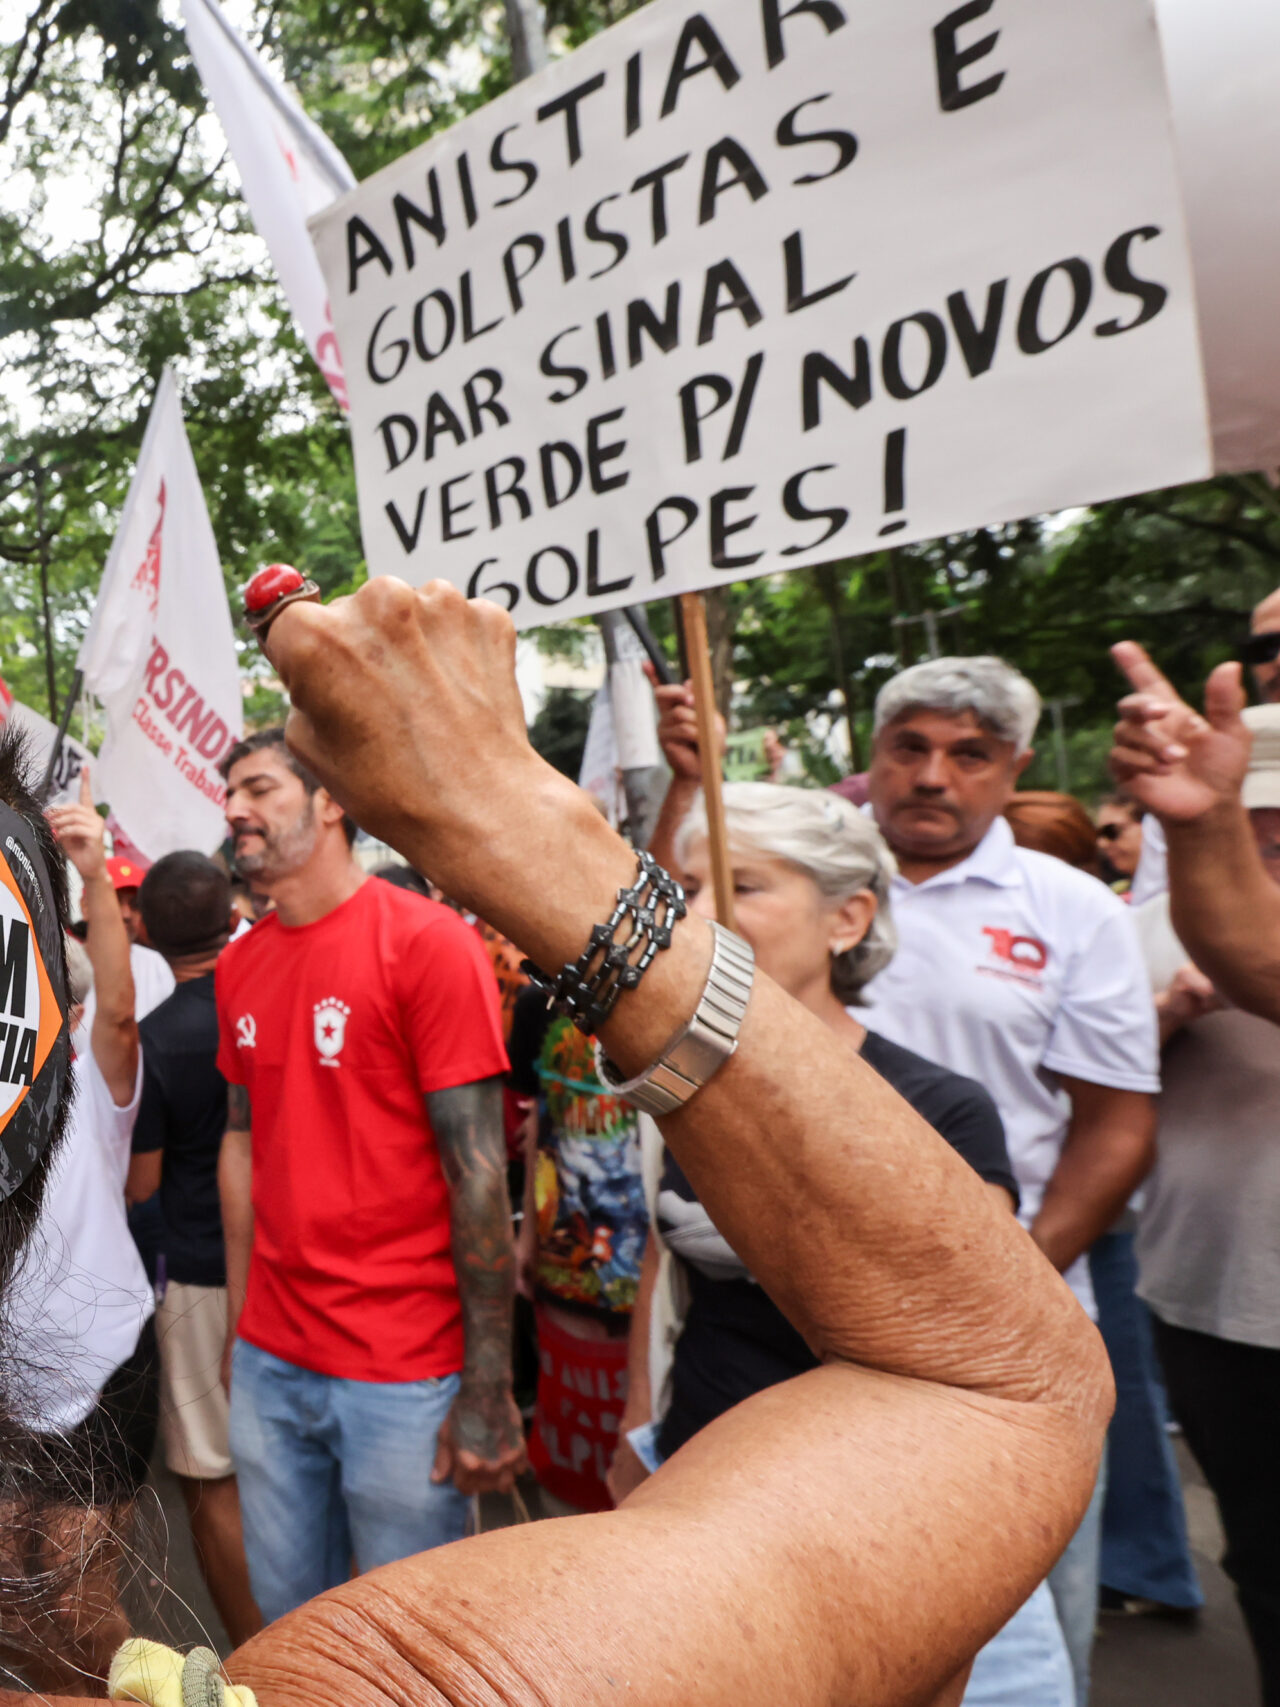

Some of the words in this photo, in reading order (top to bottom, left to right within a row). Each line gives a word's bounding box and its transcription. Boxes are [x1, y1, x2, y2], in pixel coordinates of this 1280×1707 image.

[346, 0, 848, 295] ANISTIAR
[366, 92, 859, 385] GOLPISTAS
[375, 367, 511, 473] DAR
[539, 230, 858, 402] SINAL
[384, 406, 630, 555] VERDE
[678, 350, 765, 463] P/
[801, 224, 1169, 433] NOVOS
